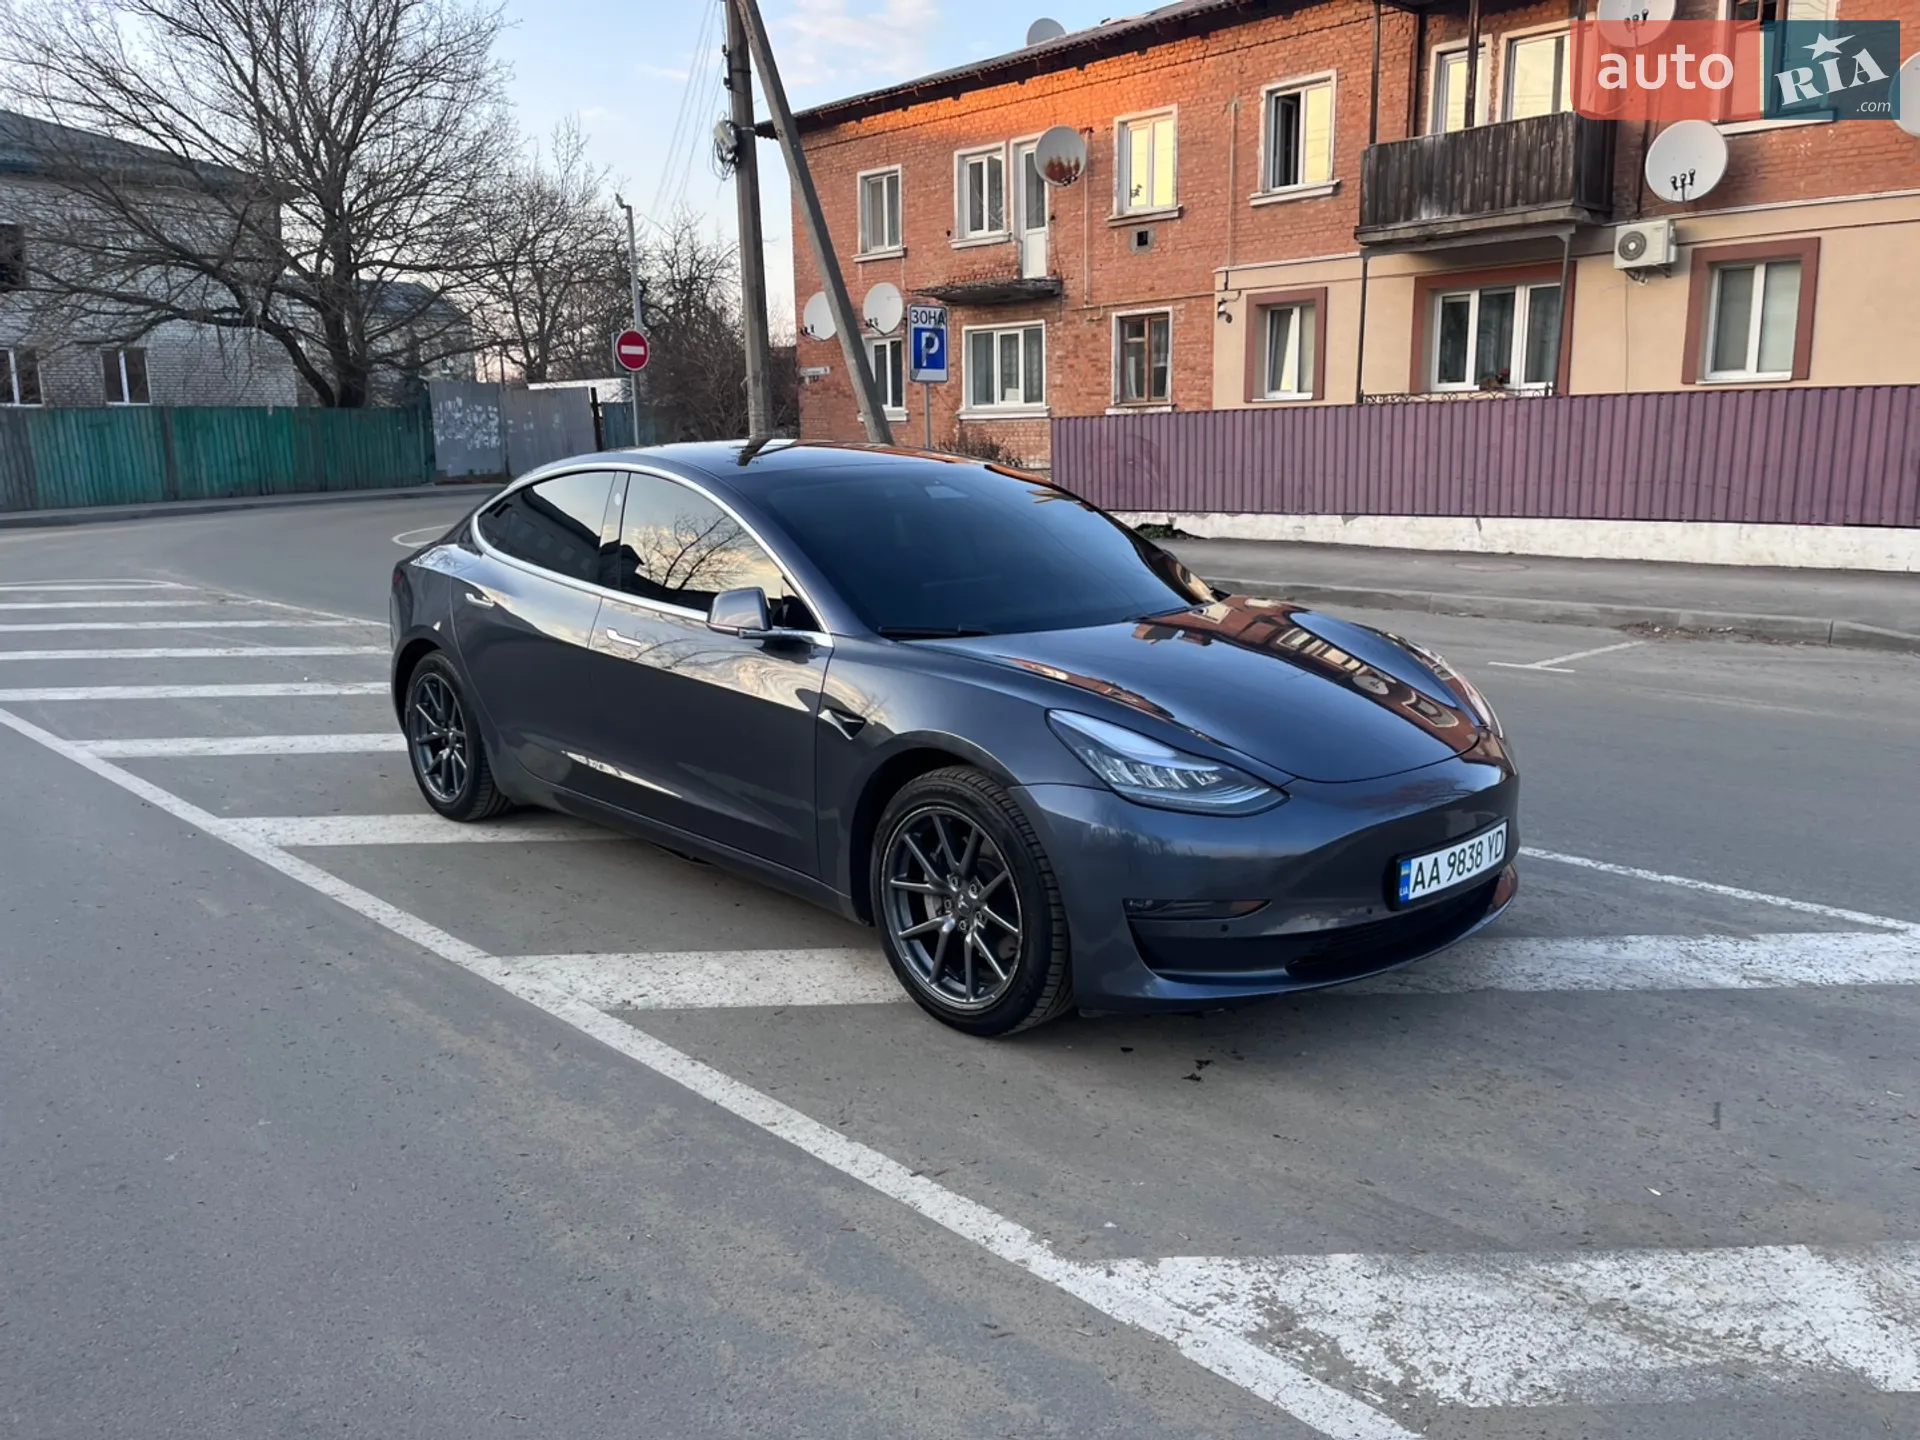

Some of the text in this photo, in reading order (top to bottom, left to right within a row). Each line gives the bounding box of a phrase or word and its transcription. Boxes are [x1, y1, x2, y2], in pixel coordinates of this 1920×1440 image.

[911, 309, 946, 325] ЗОНА
[1412, 829, 1504, 893] AA 9838 YD
